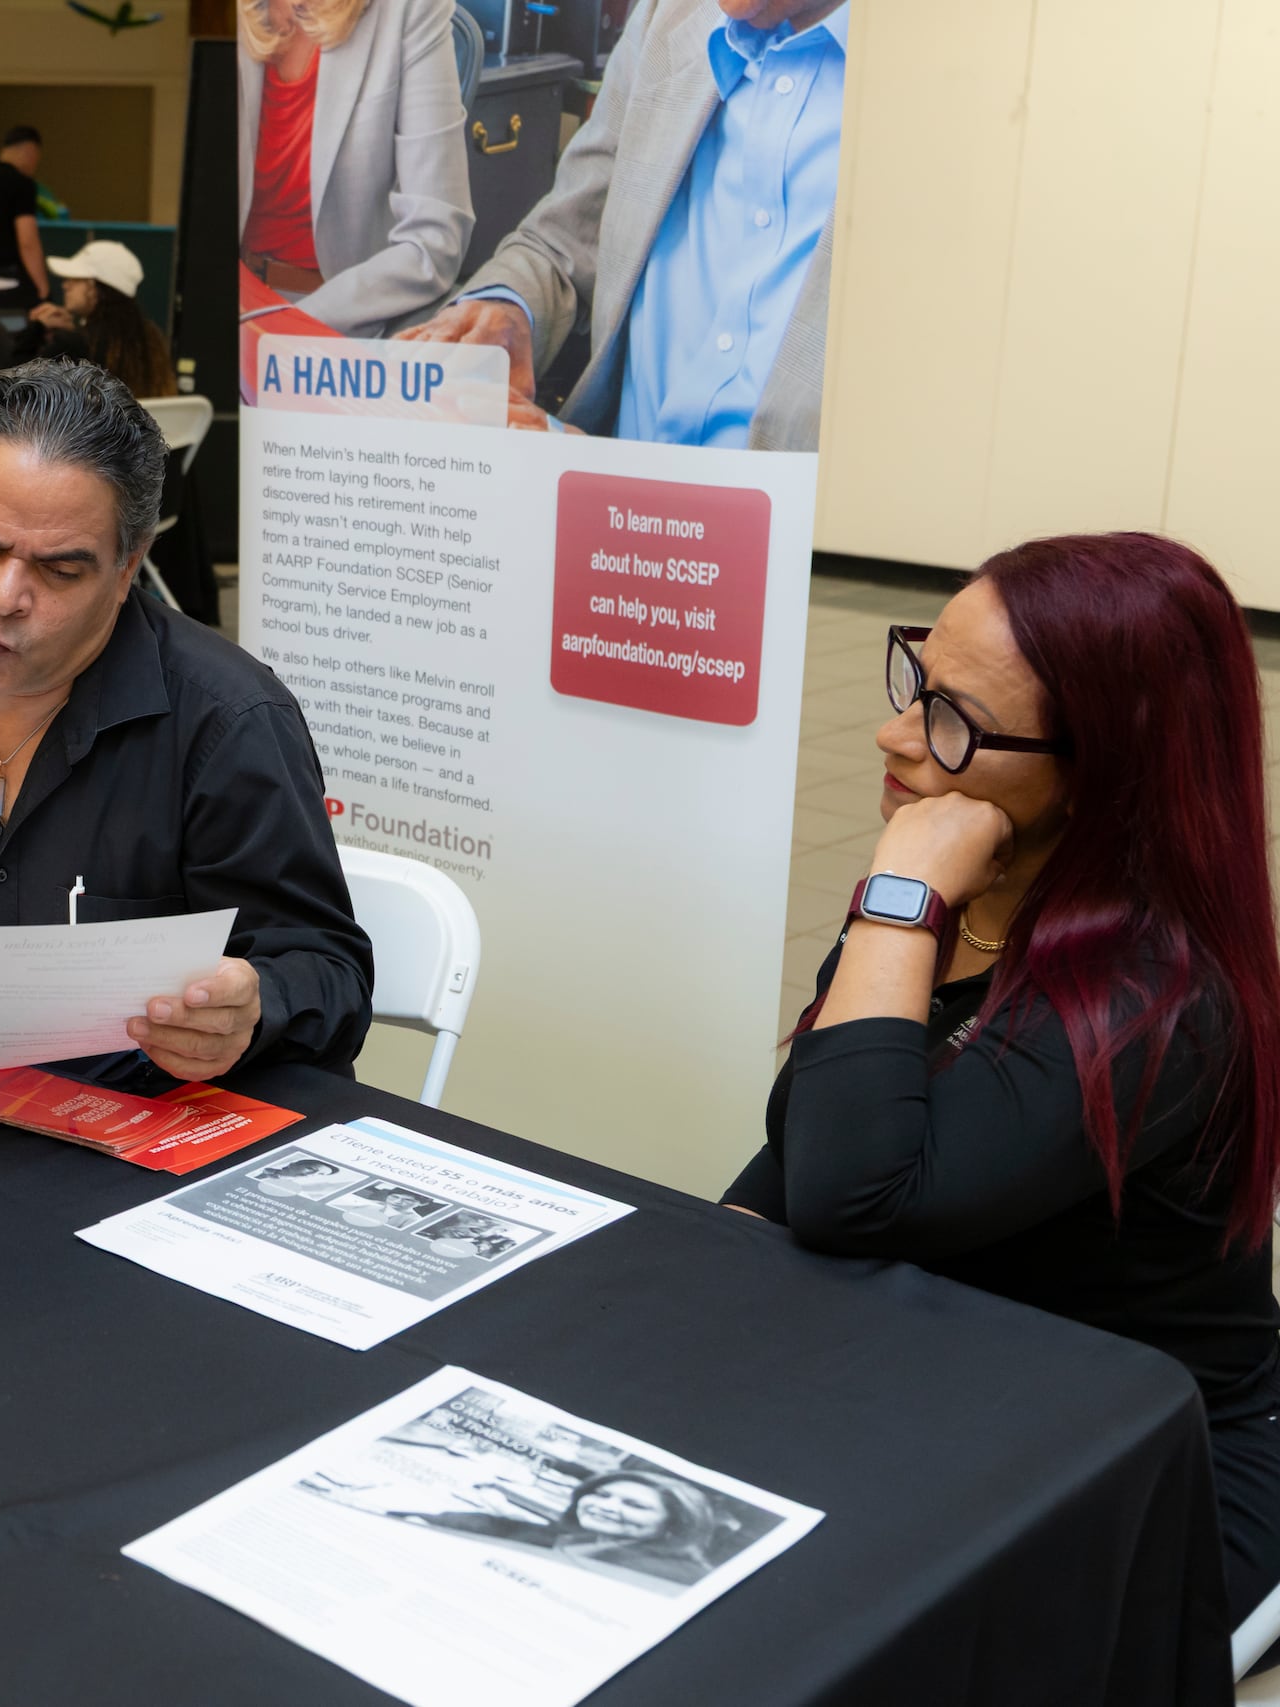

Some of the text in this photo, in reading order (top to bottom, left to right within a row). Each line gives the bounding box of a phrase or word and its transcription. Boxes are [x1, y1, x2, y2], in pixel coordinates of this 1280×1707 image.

[263, 354, 444, 402] A HAND UP
[262, 440, 492, 475] When Melvin's health forced him to
[262, 465, 436, 492] retire from laying floors, he
[262, 485, 478, 521] discovered his retirement income
[608, 506, 704, 540] To learn more
[262, 509, 472, 545] simply wasn't enough. With help
[262, 528, 500, 572] from a trained employment specialist
[590, 548, 720, 586] about how SCSEP
[262, 552, 493, 593] at AARP Foundation SCSEP (Senior
[262, 571, 471, 614] Community Service Employment
[261, 618, 373, 643] school bus driver.
[262, 593, 487, 640] Program), he landed a new job as a
[590, 595, 716, 631] can help you, visit
[261, 646, 495, 698] We also help others like Melvin enroll
[562, 633, 745, 683] aarpfoundation.org/scsep
[314, 699, 490, 743] with their taxes. Because at
[330, 681, 399, 702] assistance
[402, 693, 463, 715] programs
[466, 705, 491, 720] and
[308, 720, 461, 760] oundation, we believe in
[313, 739, 474, 784] he whole person and a
[323, 765, 493, 813] an mean a life transformed.
[350, 802, 491, 859] Foundation
[343, 833, 388, 854] without
[433, 856, 487, 881] poverty.
[329, 1132, 578, 1216] ¿Tiene usted 55 o más años
[350, 1153, 520, 1209] y necesita trabajo?
